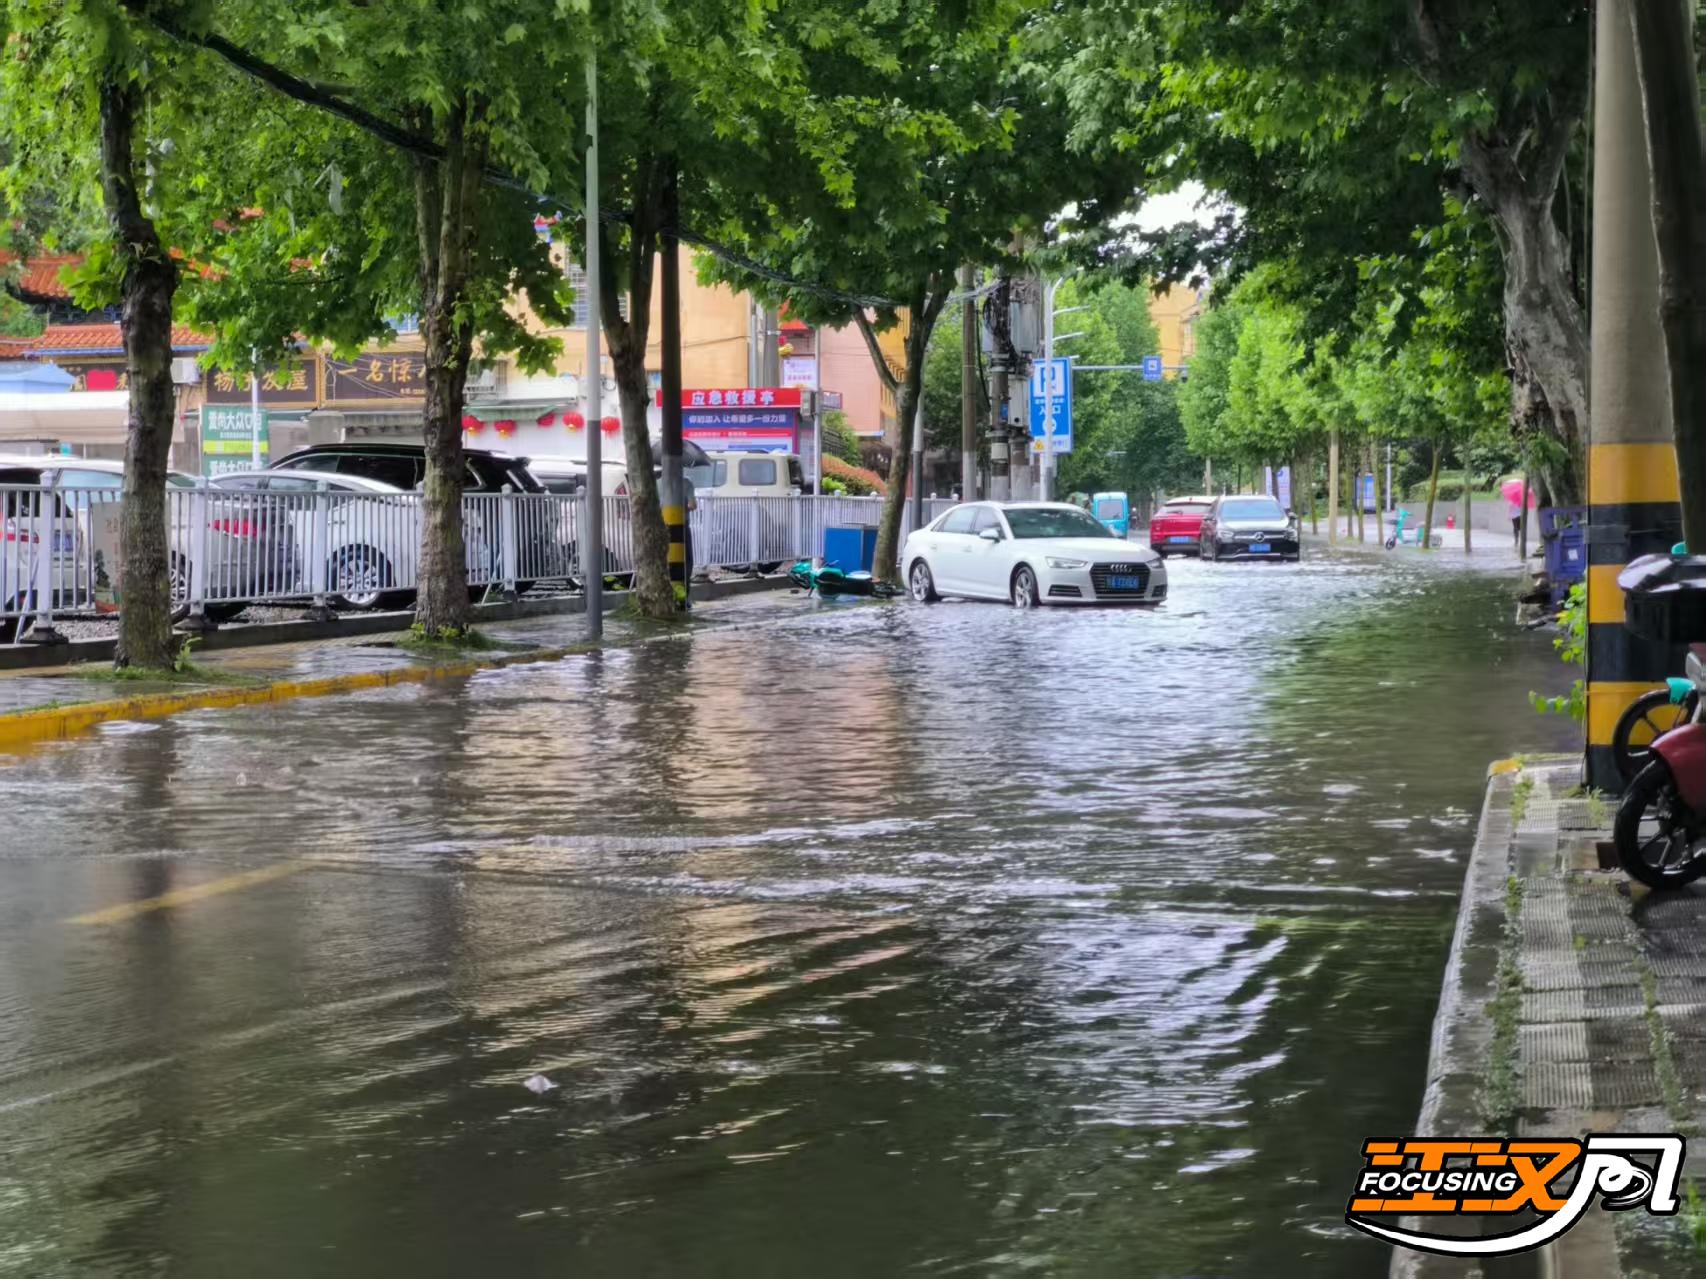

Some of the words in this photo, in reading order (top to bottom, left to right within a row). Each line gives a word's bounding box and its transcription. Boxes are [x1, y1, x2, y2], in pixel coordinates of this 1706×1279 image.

[691, 389, 774, 406] 应急救援亭
